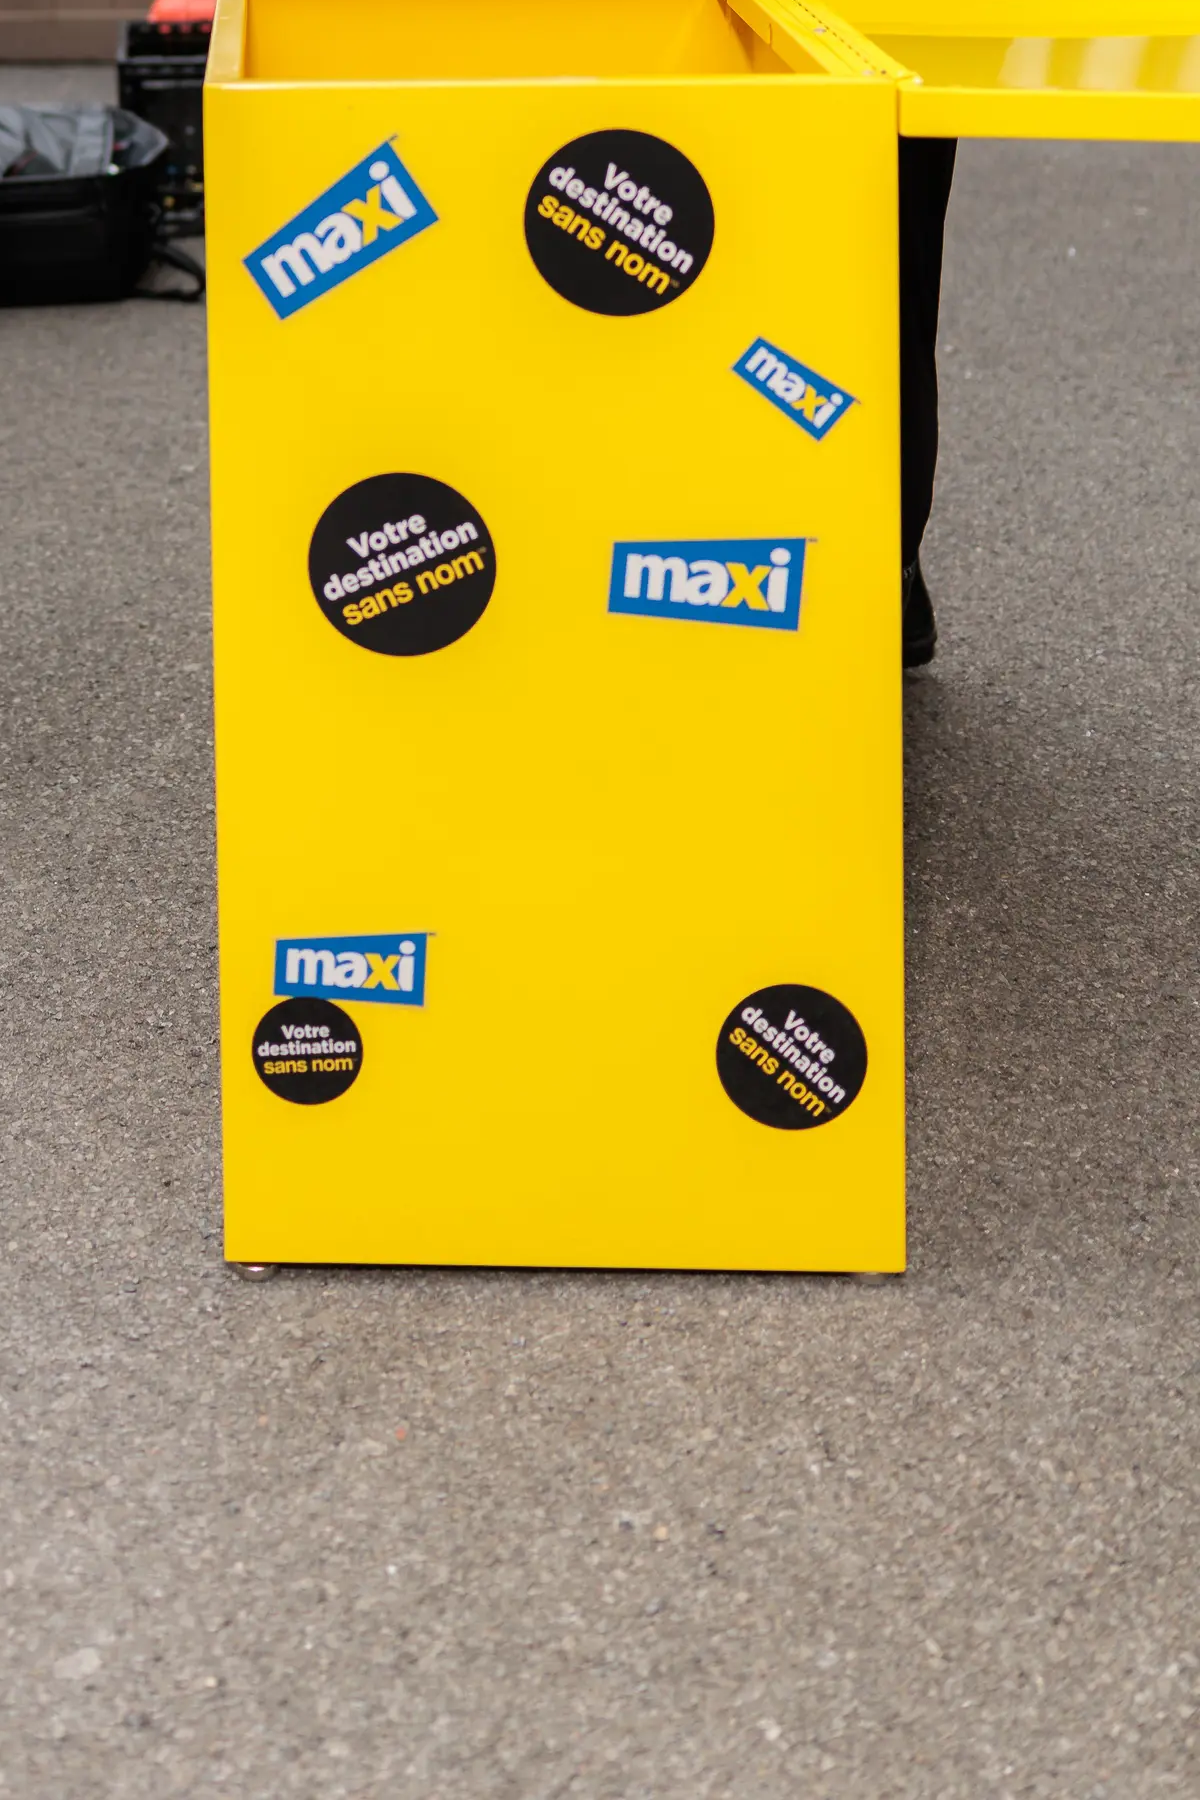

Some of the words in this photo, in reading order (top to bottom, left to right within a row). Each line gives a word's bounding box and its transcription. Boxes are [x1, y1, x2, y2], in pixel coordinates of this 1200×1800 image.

[260, 160, 418, 298] maxi
[549, 167, 693, 274] destination
[604, 162, 673, 225] Votre
[537, 195, 606, 250] sans
[604, 239, 671, 295] nom
[744, 346, 844, 429] maxi
[323, 521, 479, 601] destination
[346, 514, 427, 558] Votre
[342, 581, 414, 626] sans
[415, 550, 485, 595] nom
[623, 547, 791, 613] maxi
[285, 940, 416, 992] maxi
[257, 1038, 357, 1057] destination
[263, 1059, 307, 1074] sans
[312, 1057, 353, 1072] nom
[281, 1024, 330, 1039] Votre
[741, 1006, 846, 1104] destination
[784, 1009, 836, 1064] Votre
[728, 1027, 780, 1075] sans
[776, 1070, 826, 1117] nom
